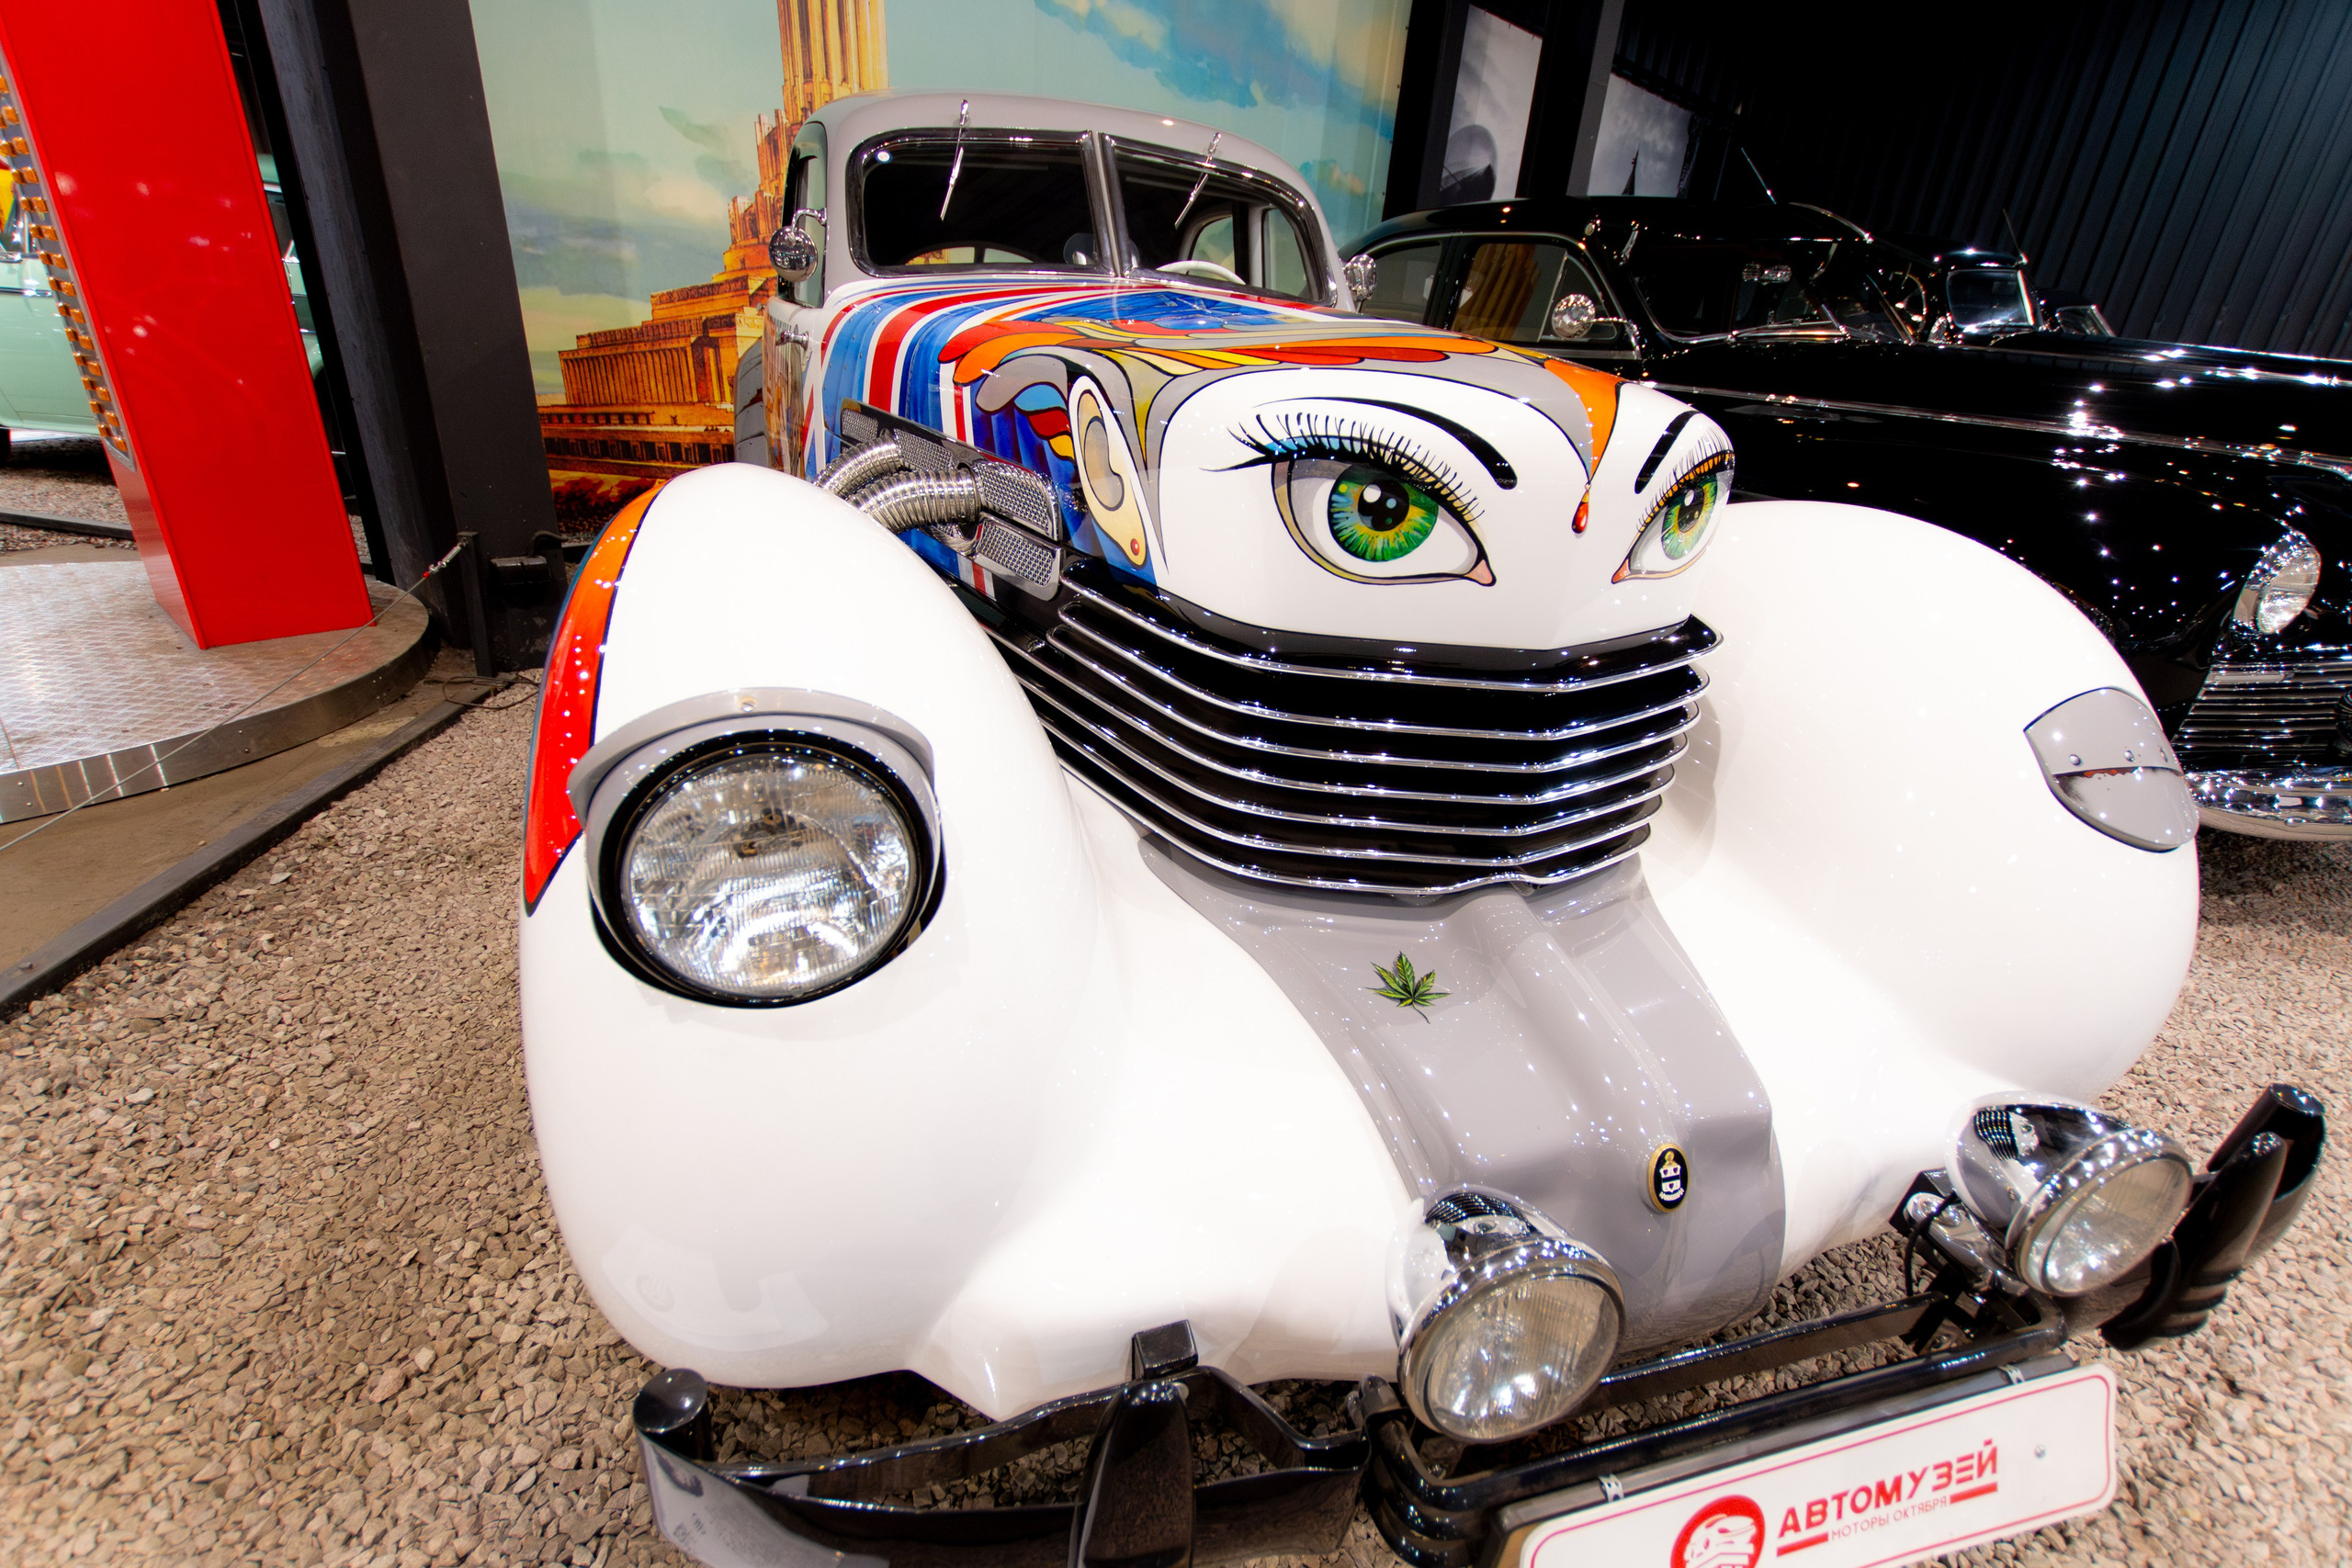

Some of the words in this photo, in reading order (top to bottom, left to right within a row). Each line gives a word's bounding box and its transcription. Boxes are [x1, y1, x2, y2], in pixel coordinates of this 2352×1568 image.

[1778, 1438, 1997, 1539] АВТОМУЗЕЙ
[1831, 1515, 1889, 1540] МОТОРЫ
[1893, 1496, 1948, 1521] ОКТЯБРЯ
